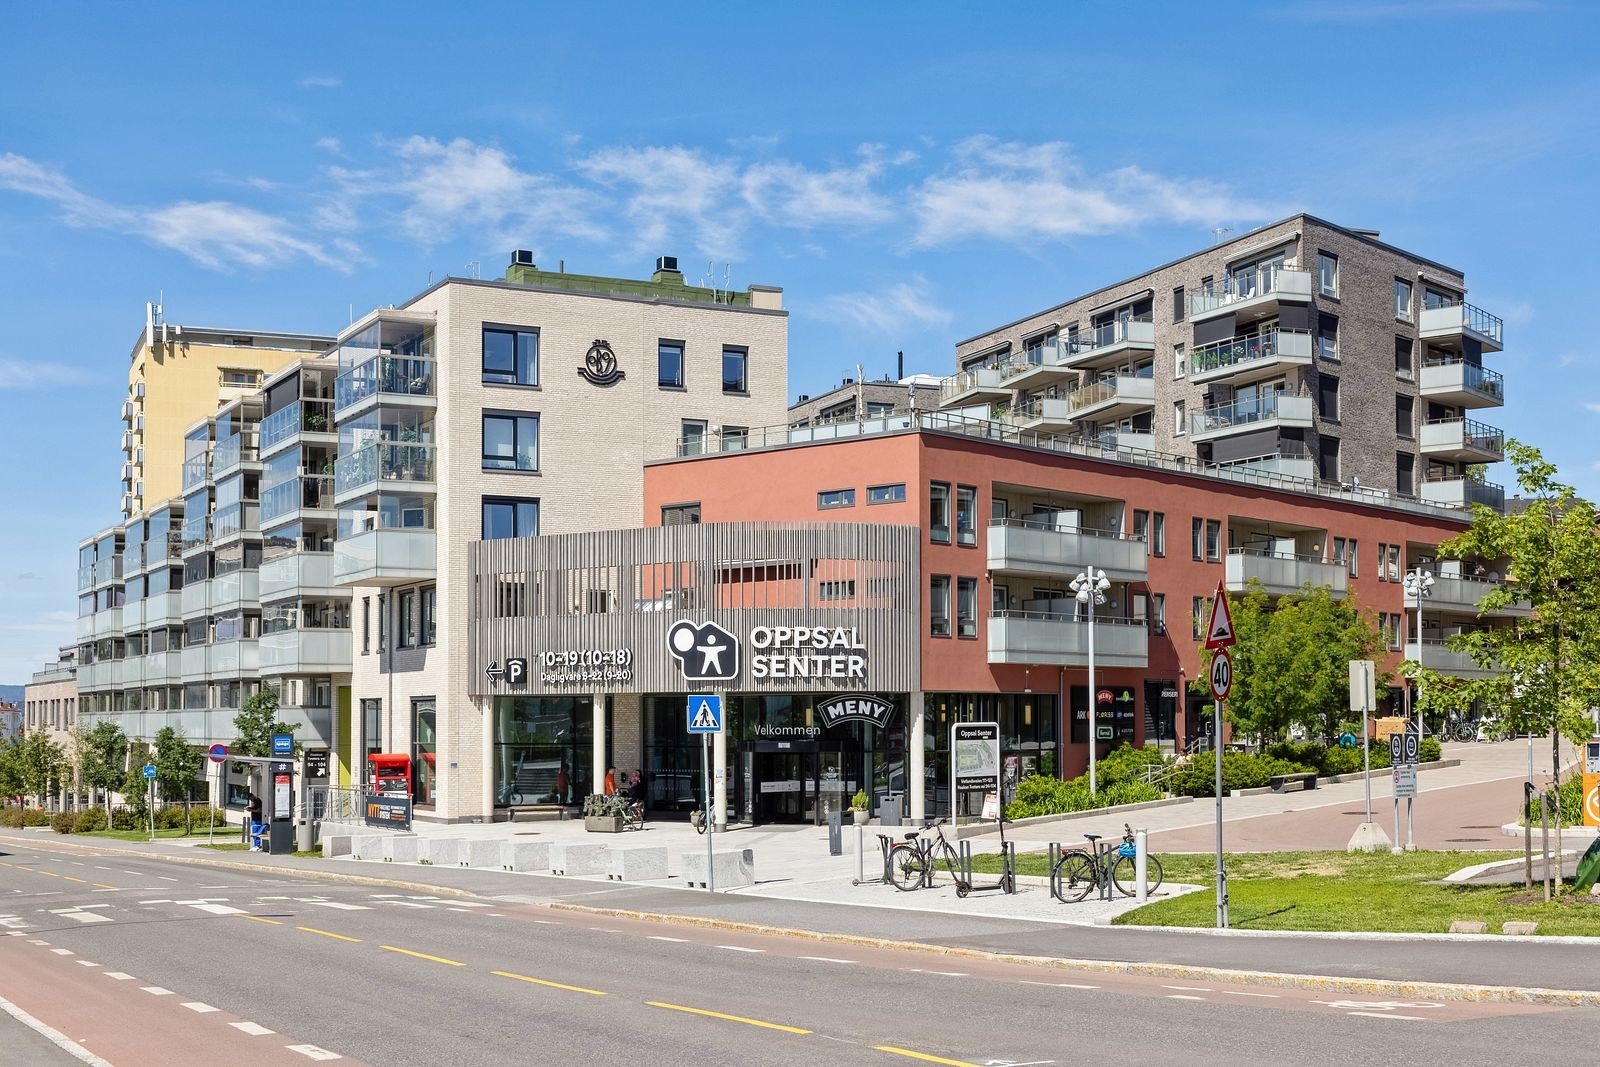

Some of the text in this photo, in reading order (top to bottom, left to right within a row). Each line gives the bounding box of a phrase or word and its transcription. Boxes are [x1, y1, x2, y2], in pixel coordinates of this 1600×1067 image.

[750, 626, 865, 649] OPPSAL
[540, 648, 631, 667] 10-19 (10-18)
[752, 654, 864, 678] SENTER
[510, 669, 522, 683] P
[541, 672, 581, 683] Dagligvare
[603, 669, 631, 681] (9-20)
[1214, 661, 1229, 688] 40
[827, 700, 886, 719] MENY
[754, 724, 821, 736] Velkommen
[960, 730, 977, 738] Oppsal
